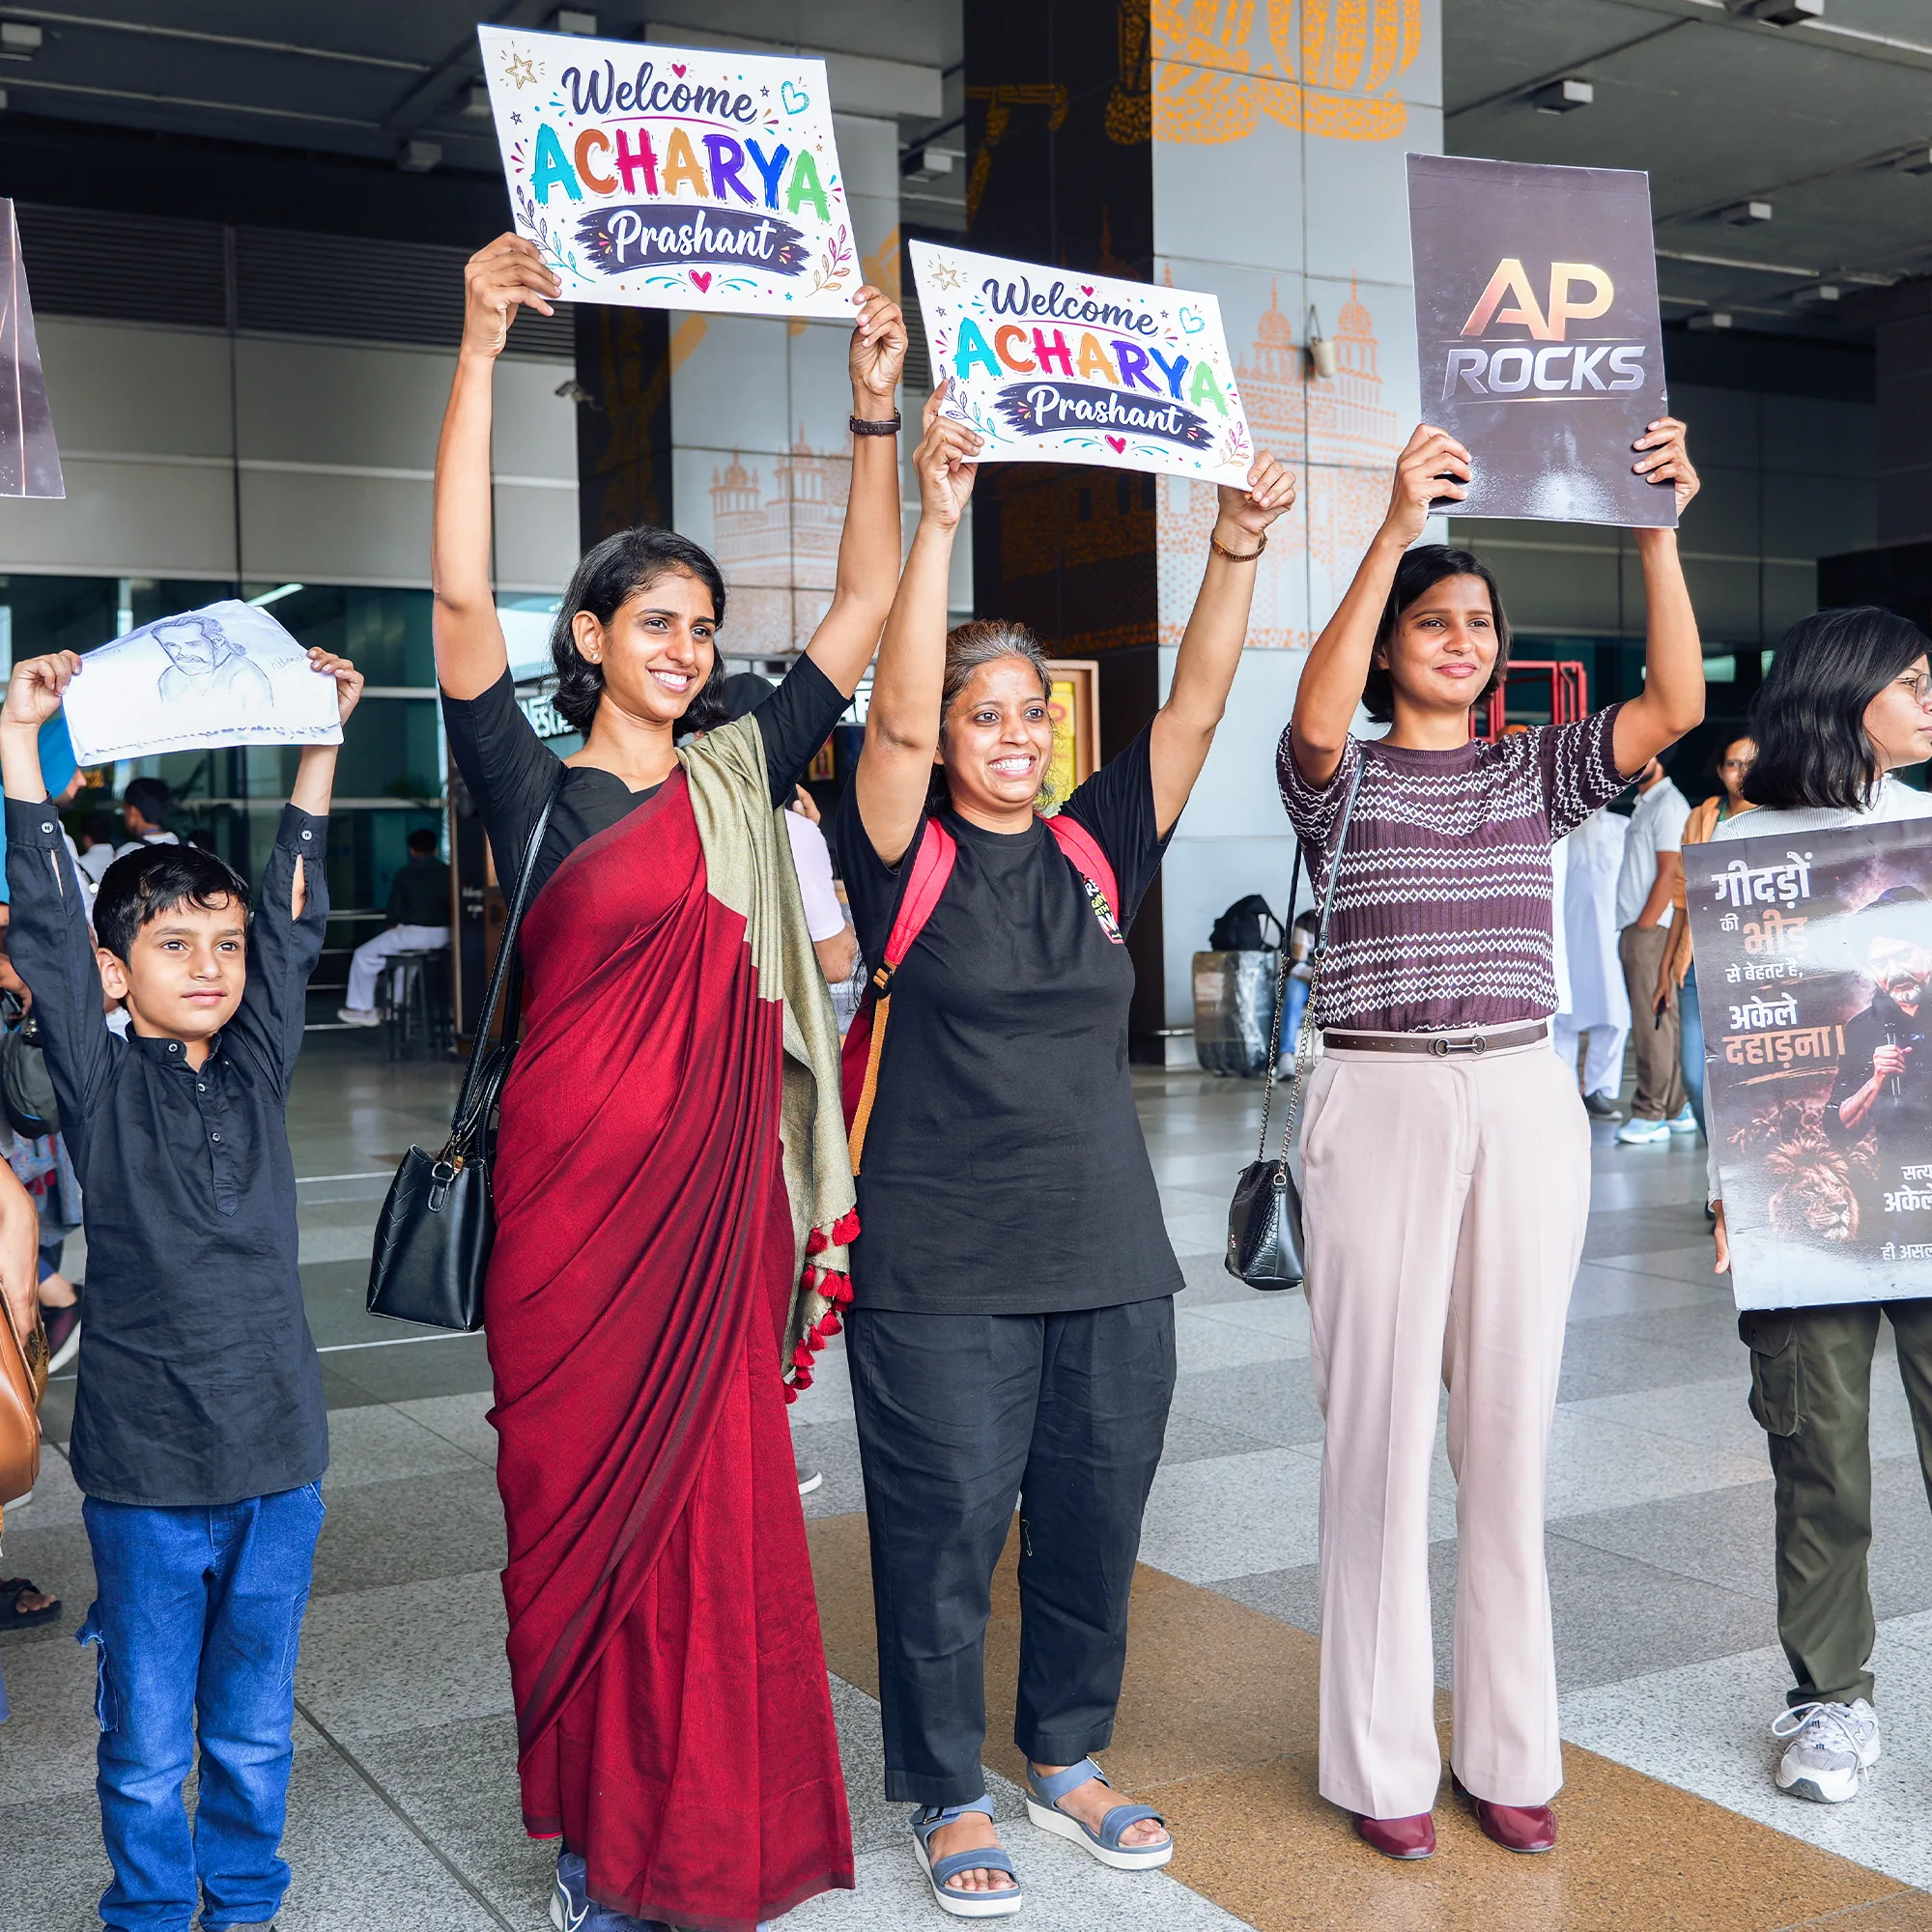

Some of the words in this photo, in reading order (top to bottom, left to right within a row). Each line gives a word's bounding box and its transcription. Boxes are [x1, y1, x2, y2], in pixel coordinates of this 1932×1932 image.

[561, 59, 757, 125] Welcome
[529, 122, 832, 222] ACHARYA
[608, 210, 777, 263] Prashant
[981, 275, 1158, 336] Welcome
[1460, 258, 1615, 342] AP
[952, 317, 1231, 417] ACHARYA
[1441, 346, 1646, 401] ROCKS
[1027, 384, 1183, 435] Prashant
[1711, 851, 1813, 909] गीदड़ों
[1719, 913, 1739, 932] की
[1724, 963, 1741, 983] से
[1743, 961, 1785, 981] बेहतर
[1729, 992, 1798, 1030] अकेले
[1880, 1241, 1896, 1261] ही
